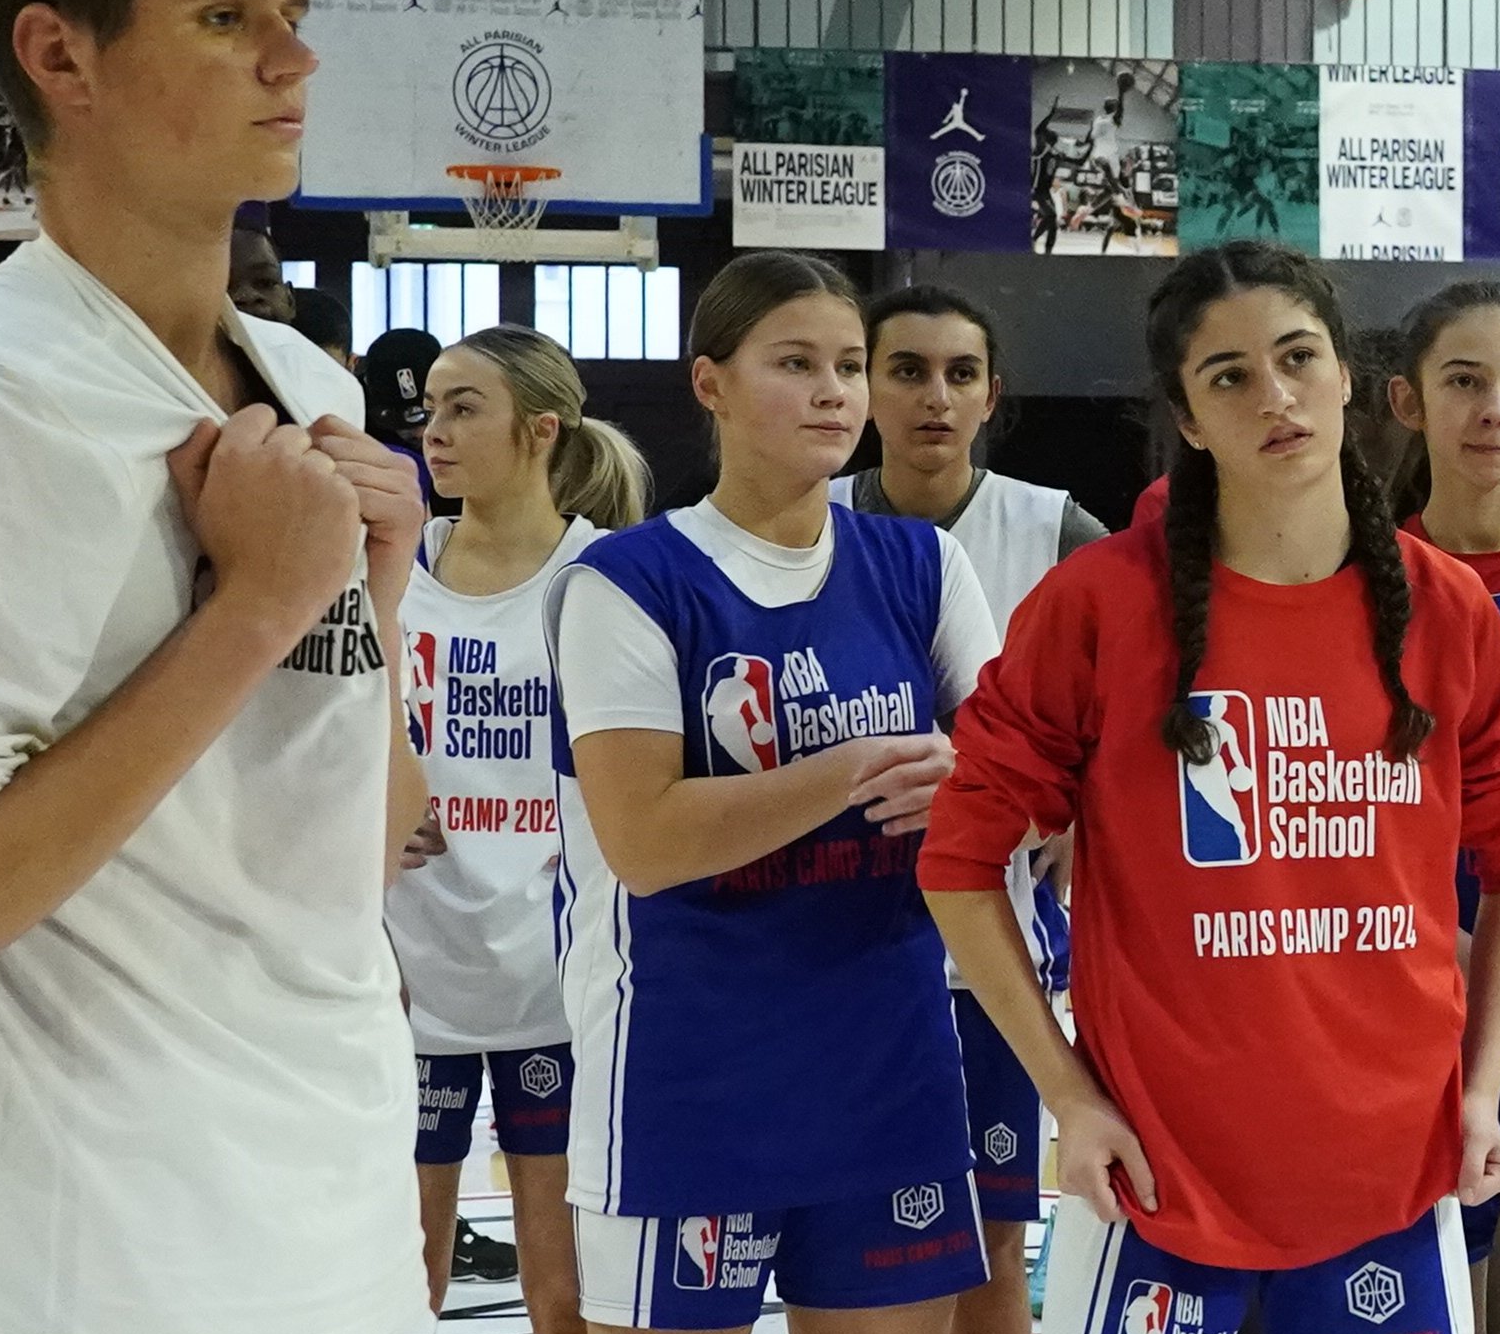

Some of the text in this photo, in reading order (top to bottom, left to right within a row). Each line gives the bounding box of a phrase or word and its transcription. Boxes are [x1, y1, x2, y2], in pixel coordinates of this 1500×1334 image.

[459, 29, 545, 55] ALL PARISIAN
[453, 122, 553, 153] WINTER LEAGUE
[1338, 138, 1444, 164] ALL PARISIAN
[740, 152, 854, 179] ALL PARISIAN
[1326, 165, 1456, 191] WINTER LEAGUE
[740, 179, 877, 206] WINTER LEAGUE
[449, 636, 497, 674] NBA
[780, 647, 829, 700] NBA
[783, 681, 916, 752] Basketball
[1265, 697, 1329, 748] NBA
[445, 718, 531, 760] School
[1268, 750, 1423, 805] Basketball
[447, 796, 508, 833] CAMP
[514, 798, 557, 833] 202
[1269, 805, 1376, 859] School
[1193, 904, 1417, 958] PARIS CAMP 2024
[726, 1212, 754, 1234] NBA
[720, 1262, 762, 1289] School
[1176, 1292, 1204, 1327] NBA
